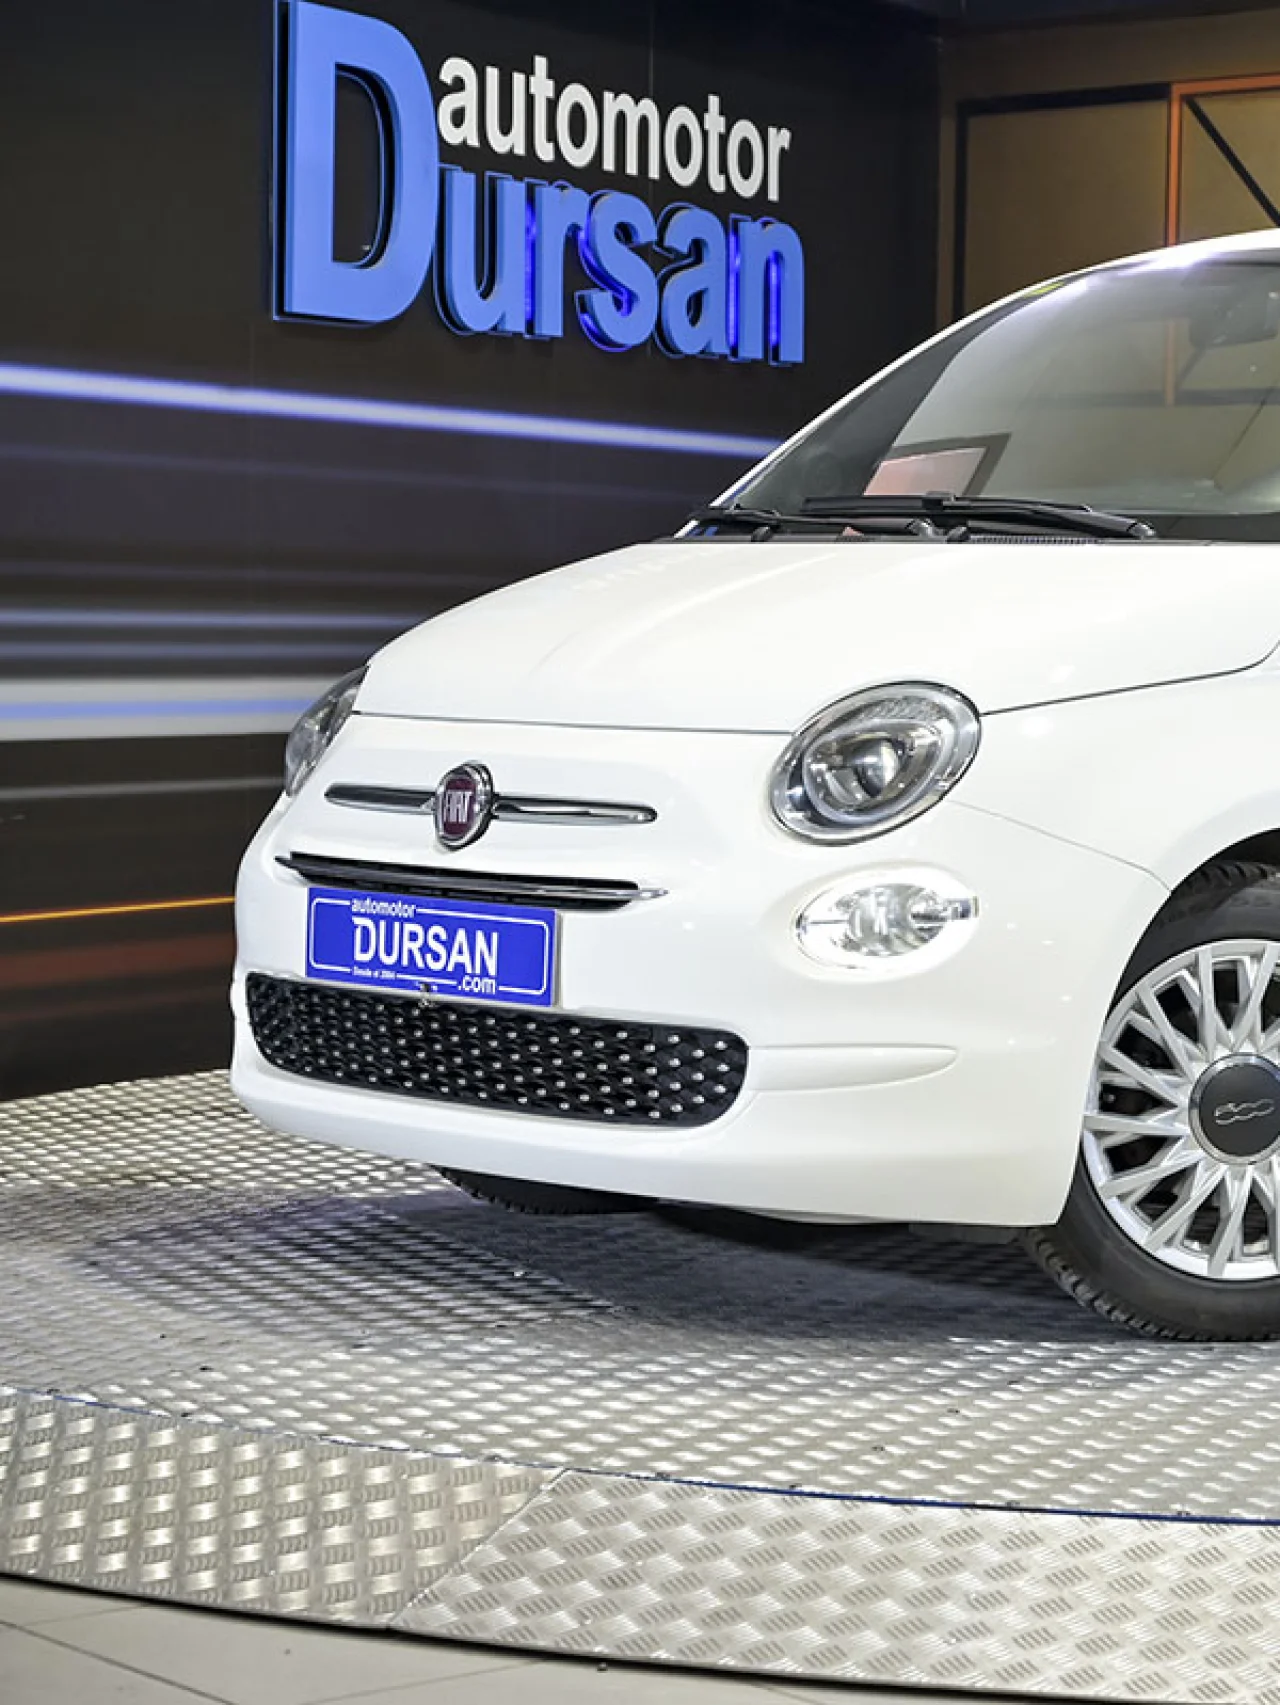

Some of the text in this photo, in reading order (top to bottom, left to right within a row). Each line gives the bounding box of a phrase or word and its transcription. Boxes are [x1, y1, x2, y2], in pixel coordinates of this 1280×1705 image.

[438, 54, 792, 202] automotor
[273, 0, 804, 366] Dursan
[443, 790, 474, 823] FIAT
[351, 897, 417, 919] automotor
[352, 915, 499, 977] DURSAN
[457, 974, 496, 995] .com
